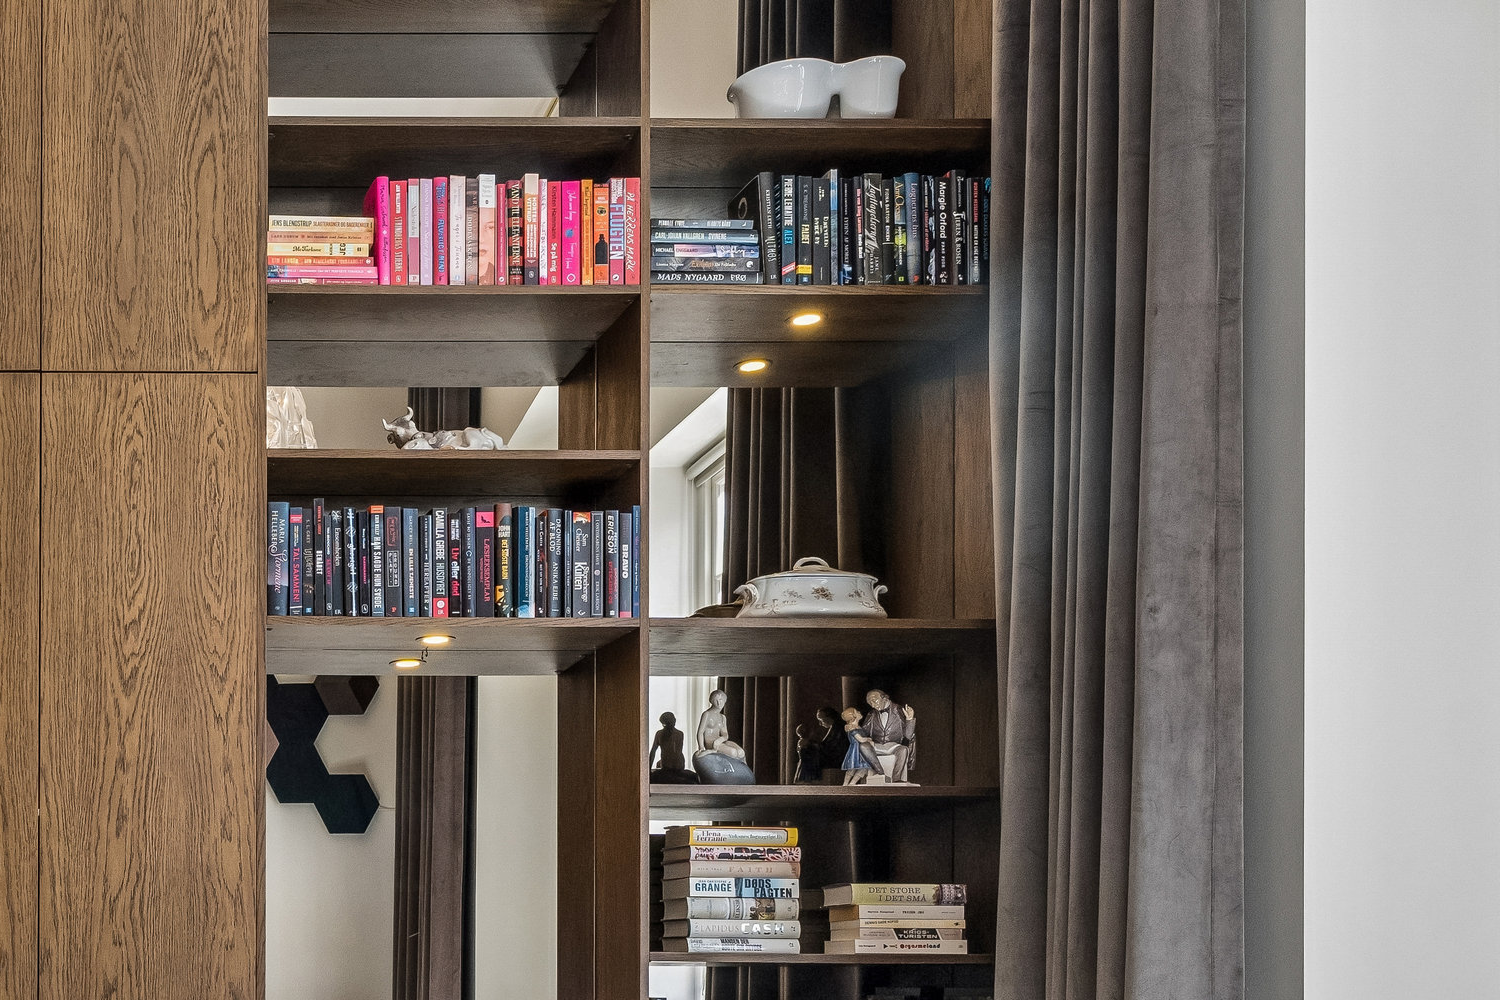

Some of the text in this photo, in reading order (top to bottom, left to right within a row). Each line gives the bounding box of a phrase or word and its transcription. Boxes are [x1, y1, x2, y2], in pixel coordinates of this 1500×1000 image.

[511, 184, 520, 205] VAND
[784, 179, 793, 198] PIERRE
[511, 205, 520, 217] TIL
[609, 204, 624, 260] FLUGTEN
[625, 192, 636, 273] PÅ HERRENS MARK
[939, 212, 947, 239] Orford
[784, 229, 793, 245] ALEX
[549, 242, 559, 273] Se på mig
[656, 274, 725, 282] MADS NYGAARD
[730, 274, 747, 282] FRØ
[435, 510, 445, 561] CAMILLA GREBE
[575, 528, 583, 553] Christer
[581, 534, 589, 547] Sam
[607, 515, 615, 554] ERICSON
[451, 548, 460, 561] Liv
[435, 562, 445, 596] HUSDYRET
[451, 561, 460, 580] eller
[574, 562, 588, 591] Kulten
[744, 879, 772, 889] DØDS
[753, 888, 793, 899] PAGTEN
[906, 894, 928, 902] SMÅ
